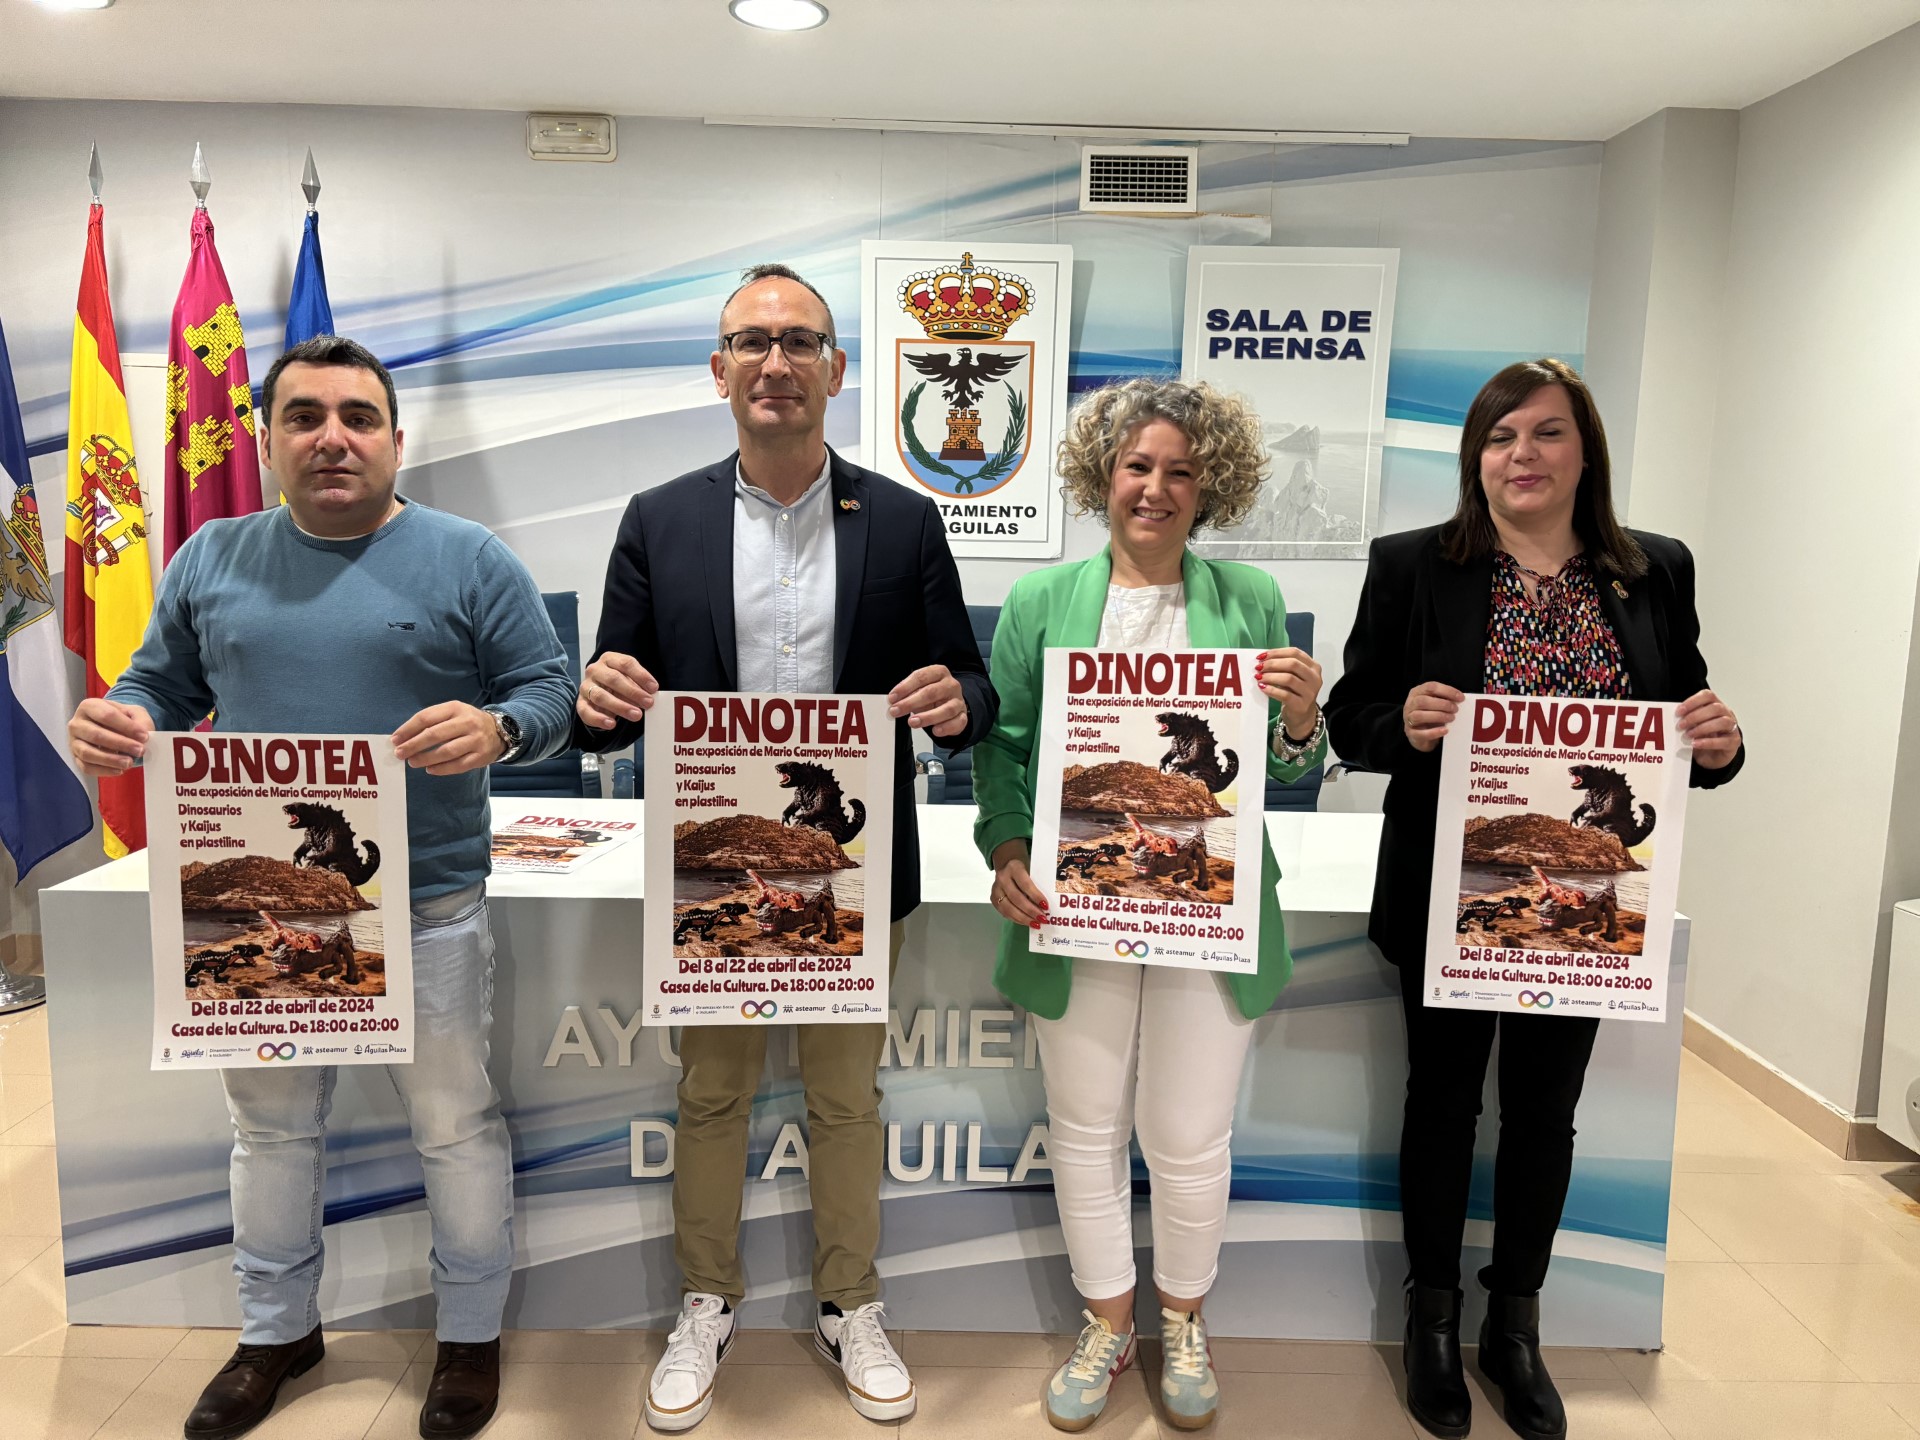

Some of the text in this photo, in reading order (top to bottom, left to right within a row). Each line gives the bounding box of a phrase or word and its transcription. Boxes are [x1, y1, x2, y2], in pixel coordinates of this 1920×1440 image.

[1206, 309, 1372, 333] SALA DE
[1209, 337, 1366, 360] PRENSA
[937, 505, 1037, 518] TAMIENTO
[943, 521, 1019, 534] GUILAS
[1068, 652, 1242, 696] DINOTEA
[1067, 696, 1242, 710] Una exposición de Mario Campoy Molero
[674, 696, 868, 744] DINOTEA
[1068, 712, 1120, 723] Dinosaurios
[1472, 699, 1665, 750] DINOTEA
[1068, 727, 1101, 739] y Kaijus
[674, 745, 868, 759] Una exposición de Mario Campoy Molero
[1066, 742, 1120, 754] en plastilina
[1471, 744, 1663, 764] Una exposición de Mario Campoy Molero
[173, 737, 378, 785] DINOTEA
[675, 763, 736, 774] Dinosaurios
[1470, 762, 1529, 775] Dinosaurios
[676, 779, 715, 793] y Kaijus
[1471, 777, 1508, 791] y Kaijus
[176, 786, 378, 800] Una exposición de Mario Campoy Molero
[1468, 793, 1528, 805] en plastilina
[675, 795, 737, 809] en plastilina
[178, 804, 242, 815] Dinosaurios
[180, 820, 221, 834] y Kaijus
[515, 816, 637, 830] DINOTEA
[180, 836, 245, 850] en plastilina
[1060, 894, 1222, 919] Del 8 al 22 de abril de 2024
[1071, 915, 1085, 928] de
[1087, 916, 1097, 929] la
[1099, 918, 1141, 932] Cultura.
[1144, 921, 1160, 934] De
[1162, 922, 1196, 936] 18:00
[1198, 928, 1205, 937] a
[1207, 926, 1244, 940] 20:00
[1166, 949, 1195, 957] asteamur
[1460, 947, 1629, 970] Del 8 al 22 de abril de 2024
[679, 958, 851, 973] Del 8 al 22 de abril de 2024
[1441, 966, 1652, 990] Casa de la Cultura. De 18:00 a 20:00
[660, 978, 874, 993] Casa de la Cultura. De 18:00 a 20:00
[192, 998, 374, 1016] Del 8 al 22 de abril de 2024
[172, 1018, 399, 1036] Casa de la Cultura. De 18:00 a 20:00
[761, 1119, 1056, 1182] AUILA
